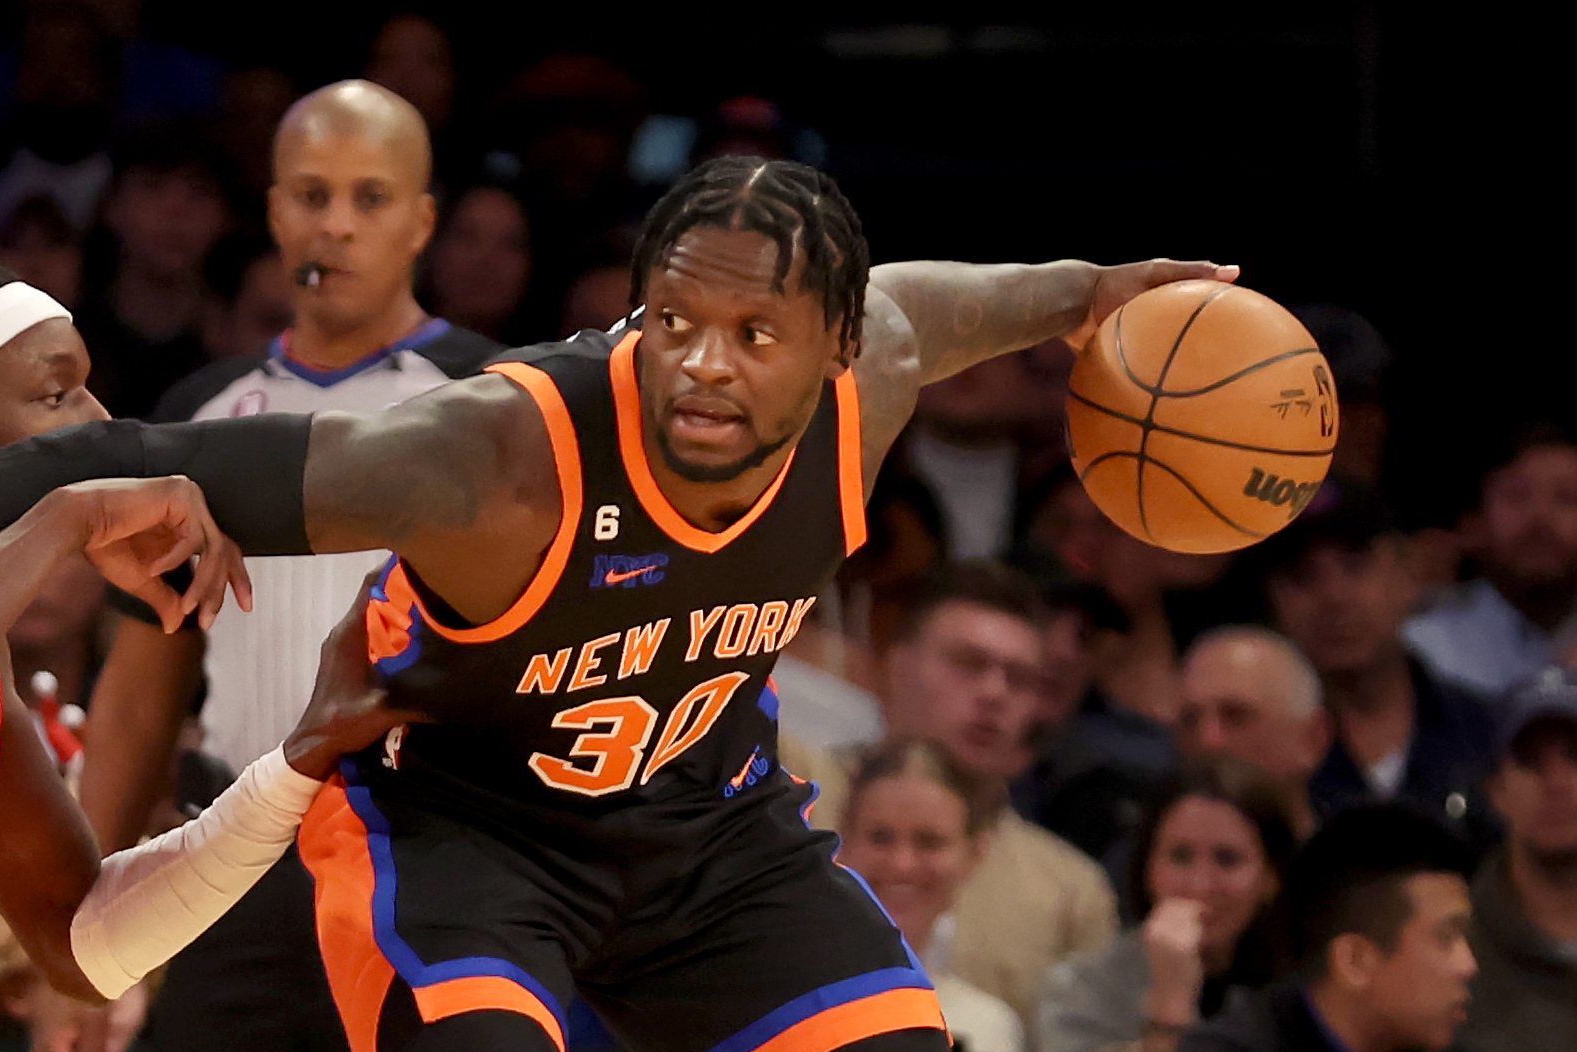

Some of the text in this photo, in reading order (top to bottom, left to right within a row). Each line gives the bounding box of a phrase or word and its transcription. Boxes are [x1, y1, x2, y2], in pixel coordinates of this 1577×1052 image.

[594, 504, 620, 541] 6
[516, 596, 817, 693] NEW YORK
[528, 671, 750, 797] 30
